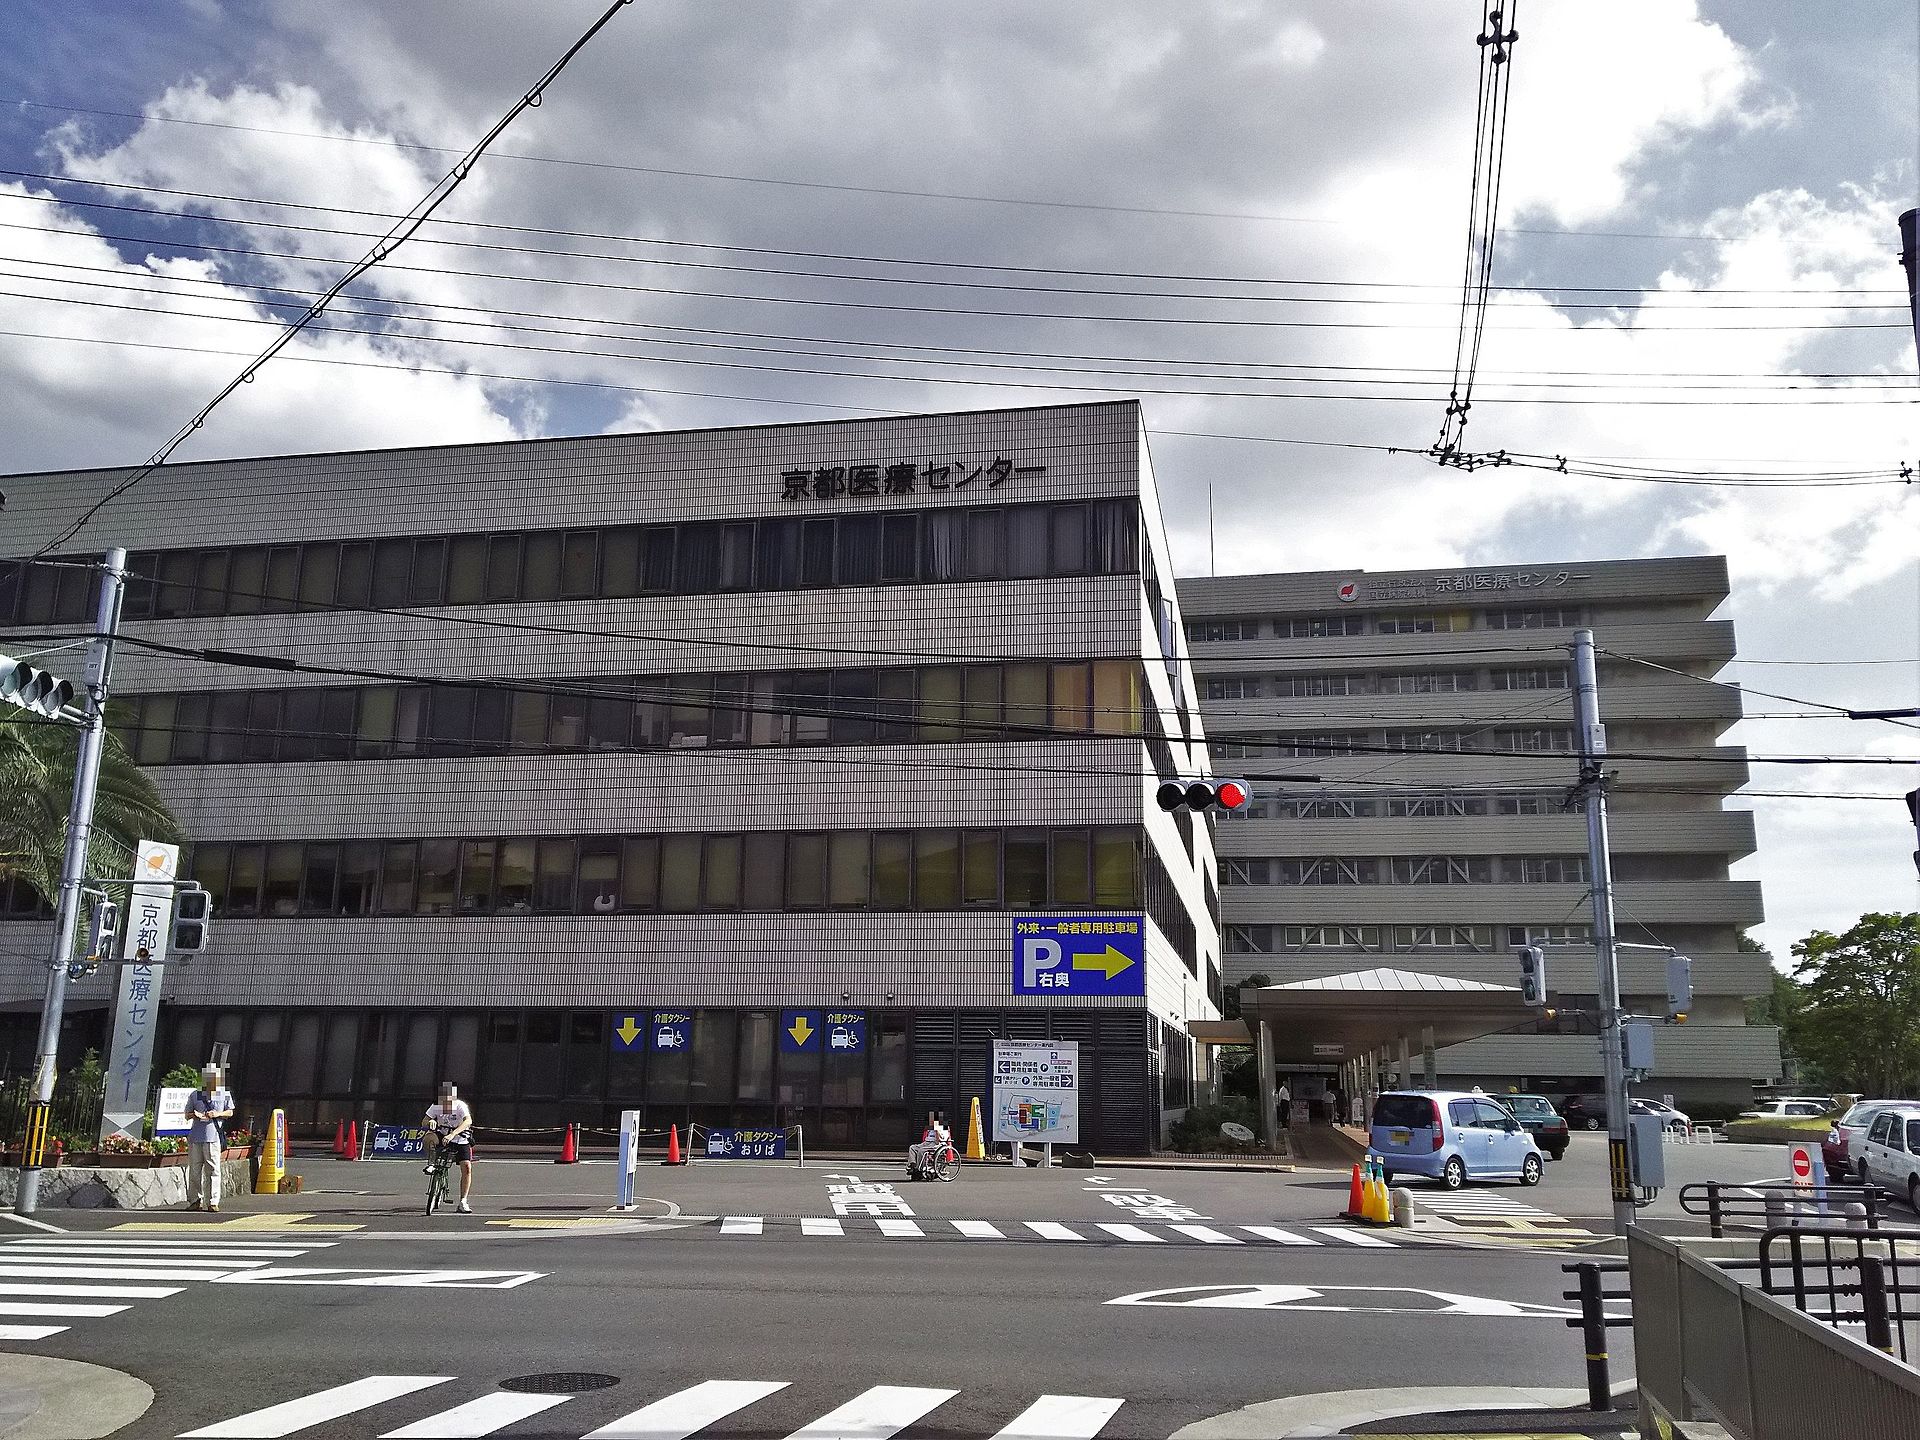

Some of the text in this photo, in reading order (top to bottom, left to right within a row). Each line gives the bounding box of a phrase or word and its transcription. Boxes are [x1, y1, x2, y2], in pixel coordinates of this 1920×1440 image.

[780, 455, 1047, 500] 京都医療センター
[1434, 571, 1591, 592] 京都医療センター
[1017, 922, 1138, 934] 外来・一般者専用駐車場
[1023, 938, 1062, 988] P
[1039, 972, 1070, 987] 右奥
[654, 1013, 691, 1024] 介護タクシー
[827, 1013, 865, 1024] 介護タクシー
[734, 1131, 784, 1142] 介護タクシー
[741, 1143, 776, 1155] おりば
